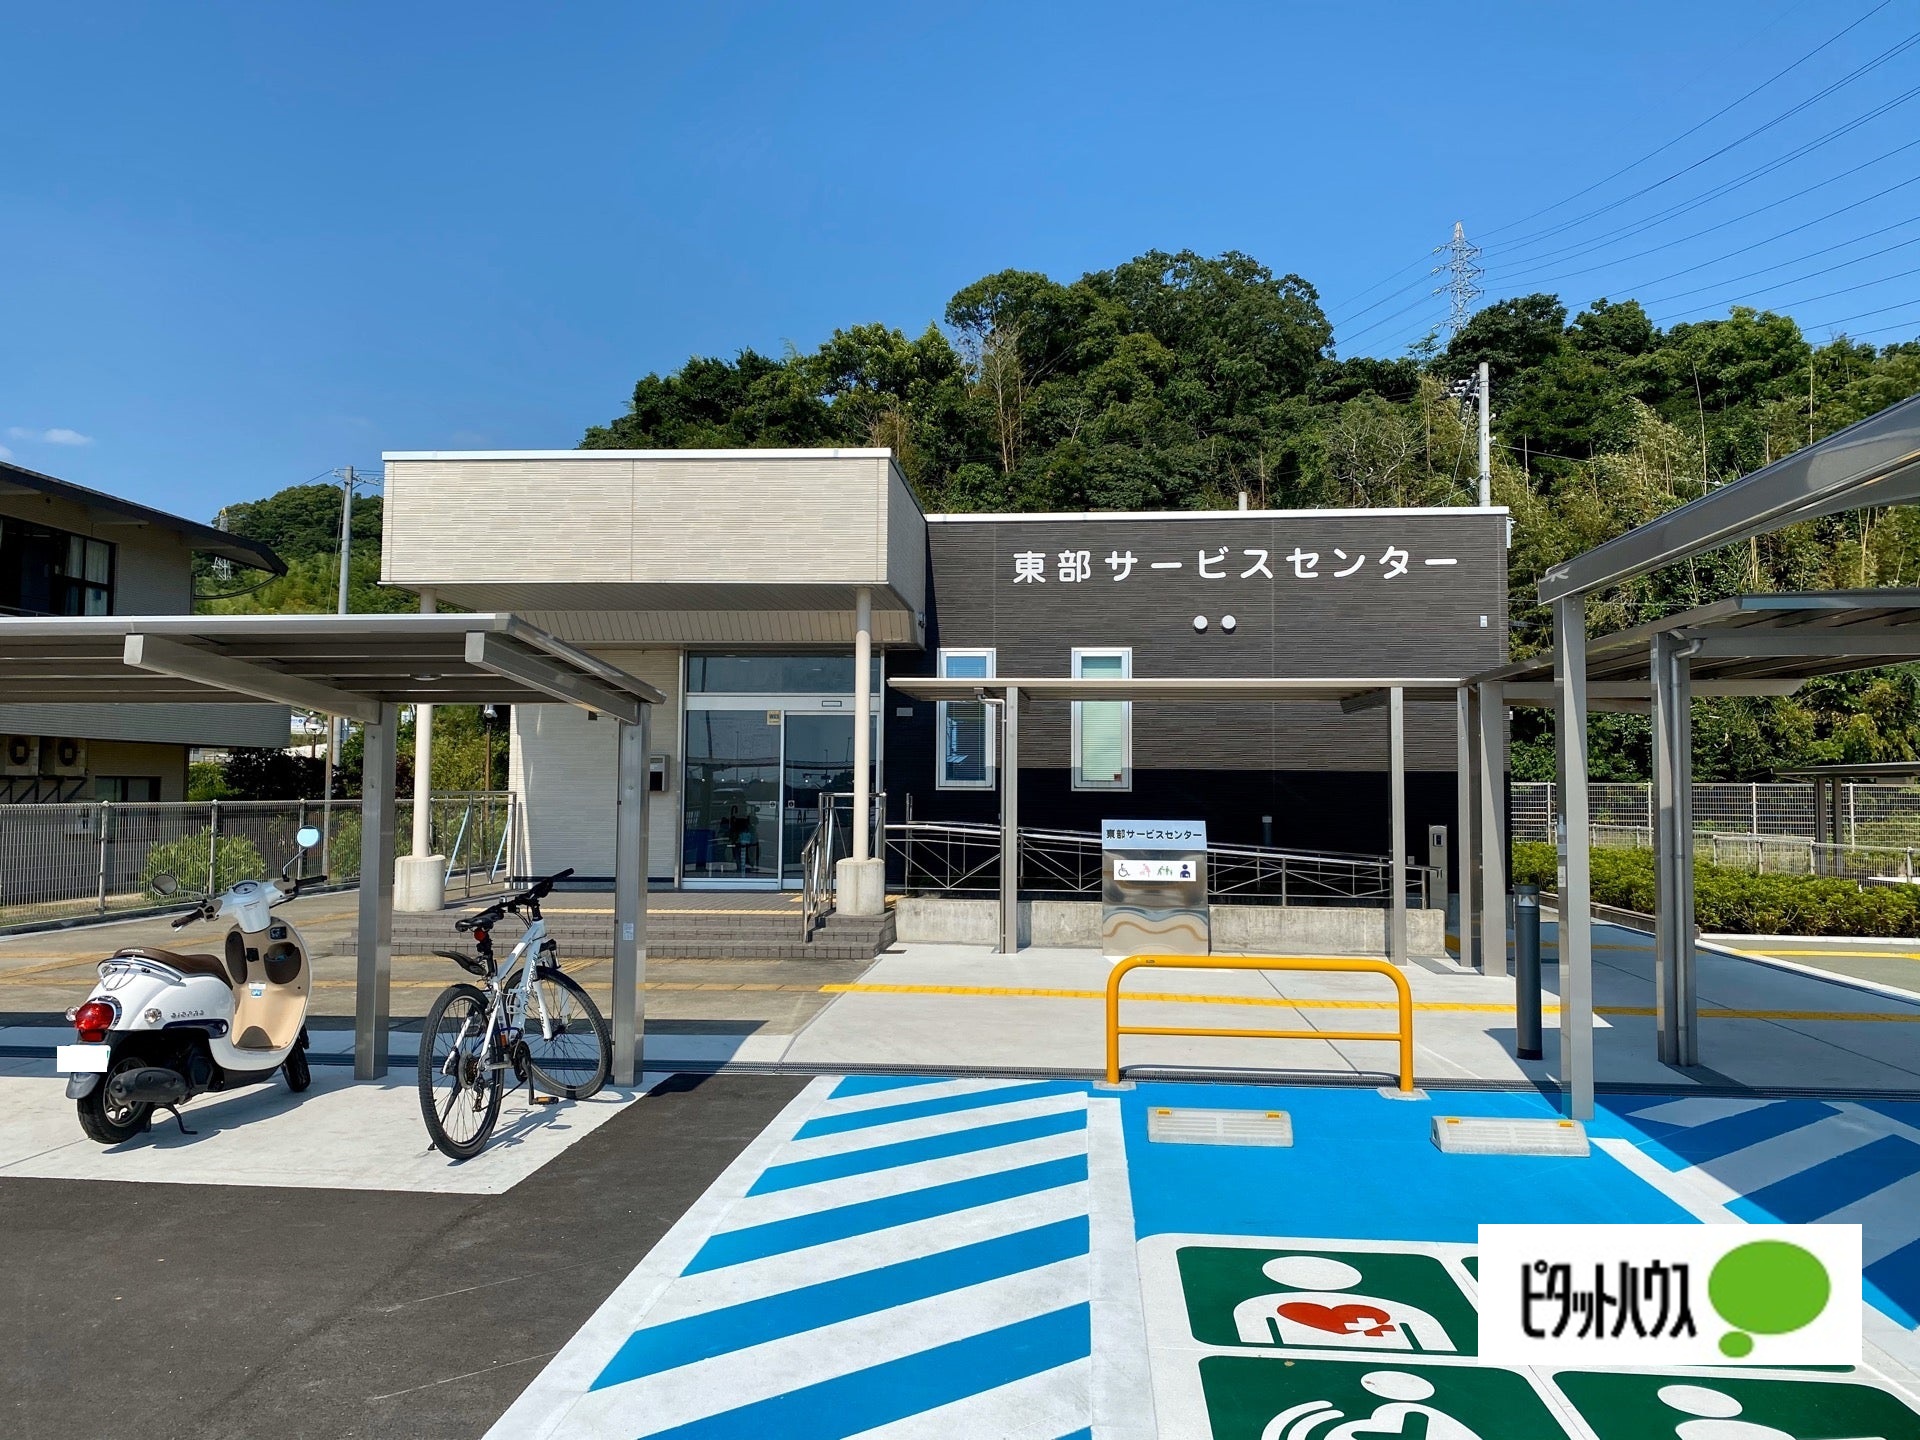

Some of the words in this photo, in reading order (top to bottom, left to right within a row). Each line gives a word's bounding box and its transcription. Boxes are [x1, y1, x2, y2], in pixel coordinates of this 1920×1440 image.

[1012, 546, 1459, 584] 東部サービスセンター
[1106, 829, 1202, 840] 東部サービスセンター
